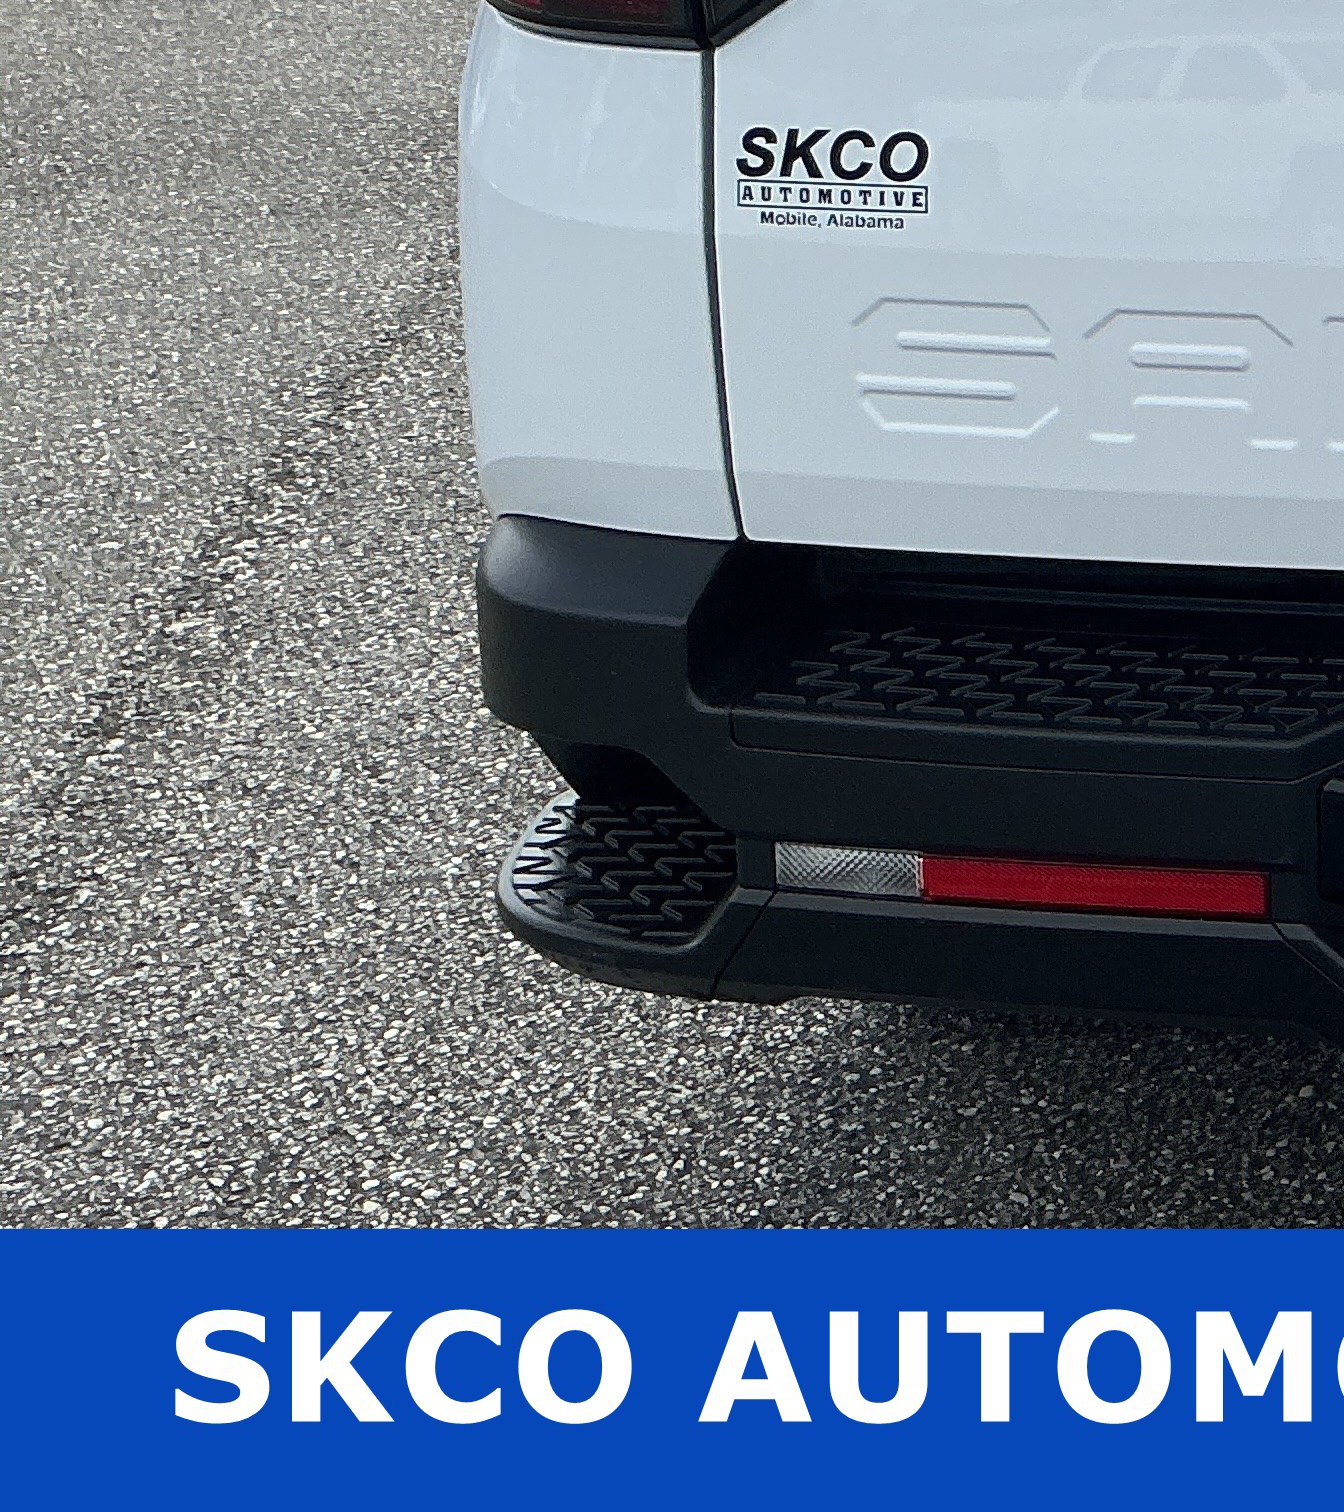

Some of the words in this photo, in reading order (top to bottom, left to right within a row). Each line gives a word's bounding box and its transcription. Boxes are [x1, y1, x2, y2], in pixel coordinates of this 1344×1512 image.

[736, 127, 929, 182] SKCO
[742, 186, 924, 207] AUTOMOTIVE
[760, 211, 822, 228] Mobile,
[827, 213, 905, 229] Alabama
